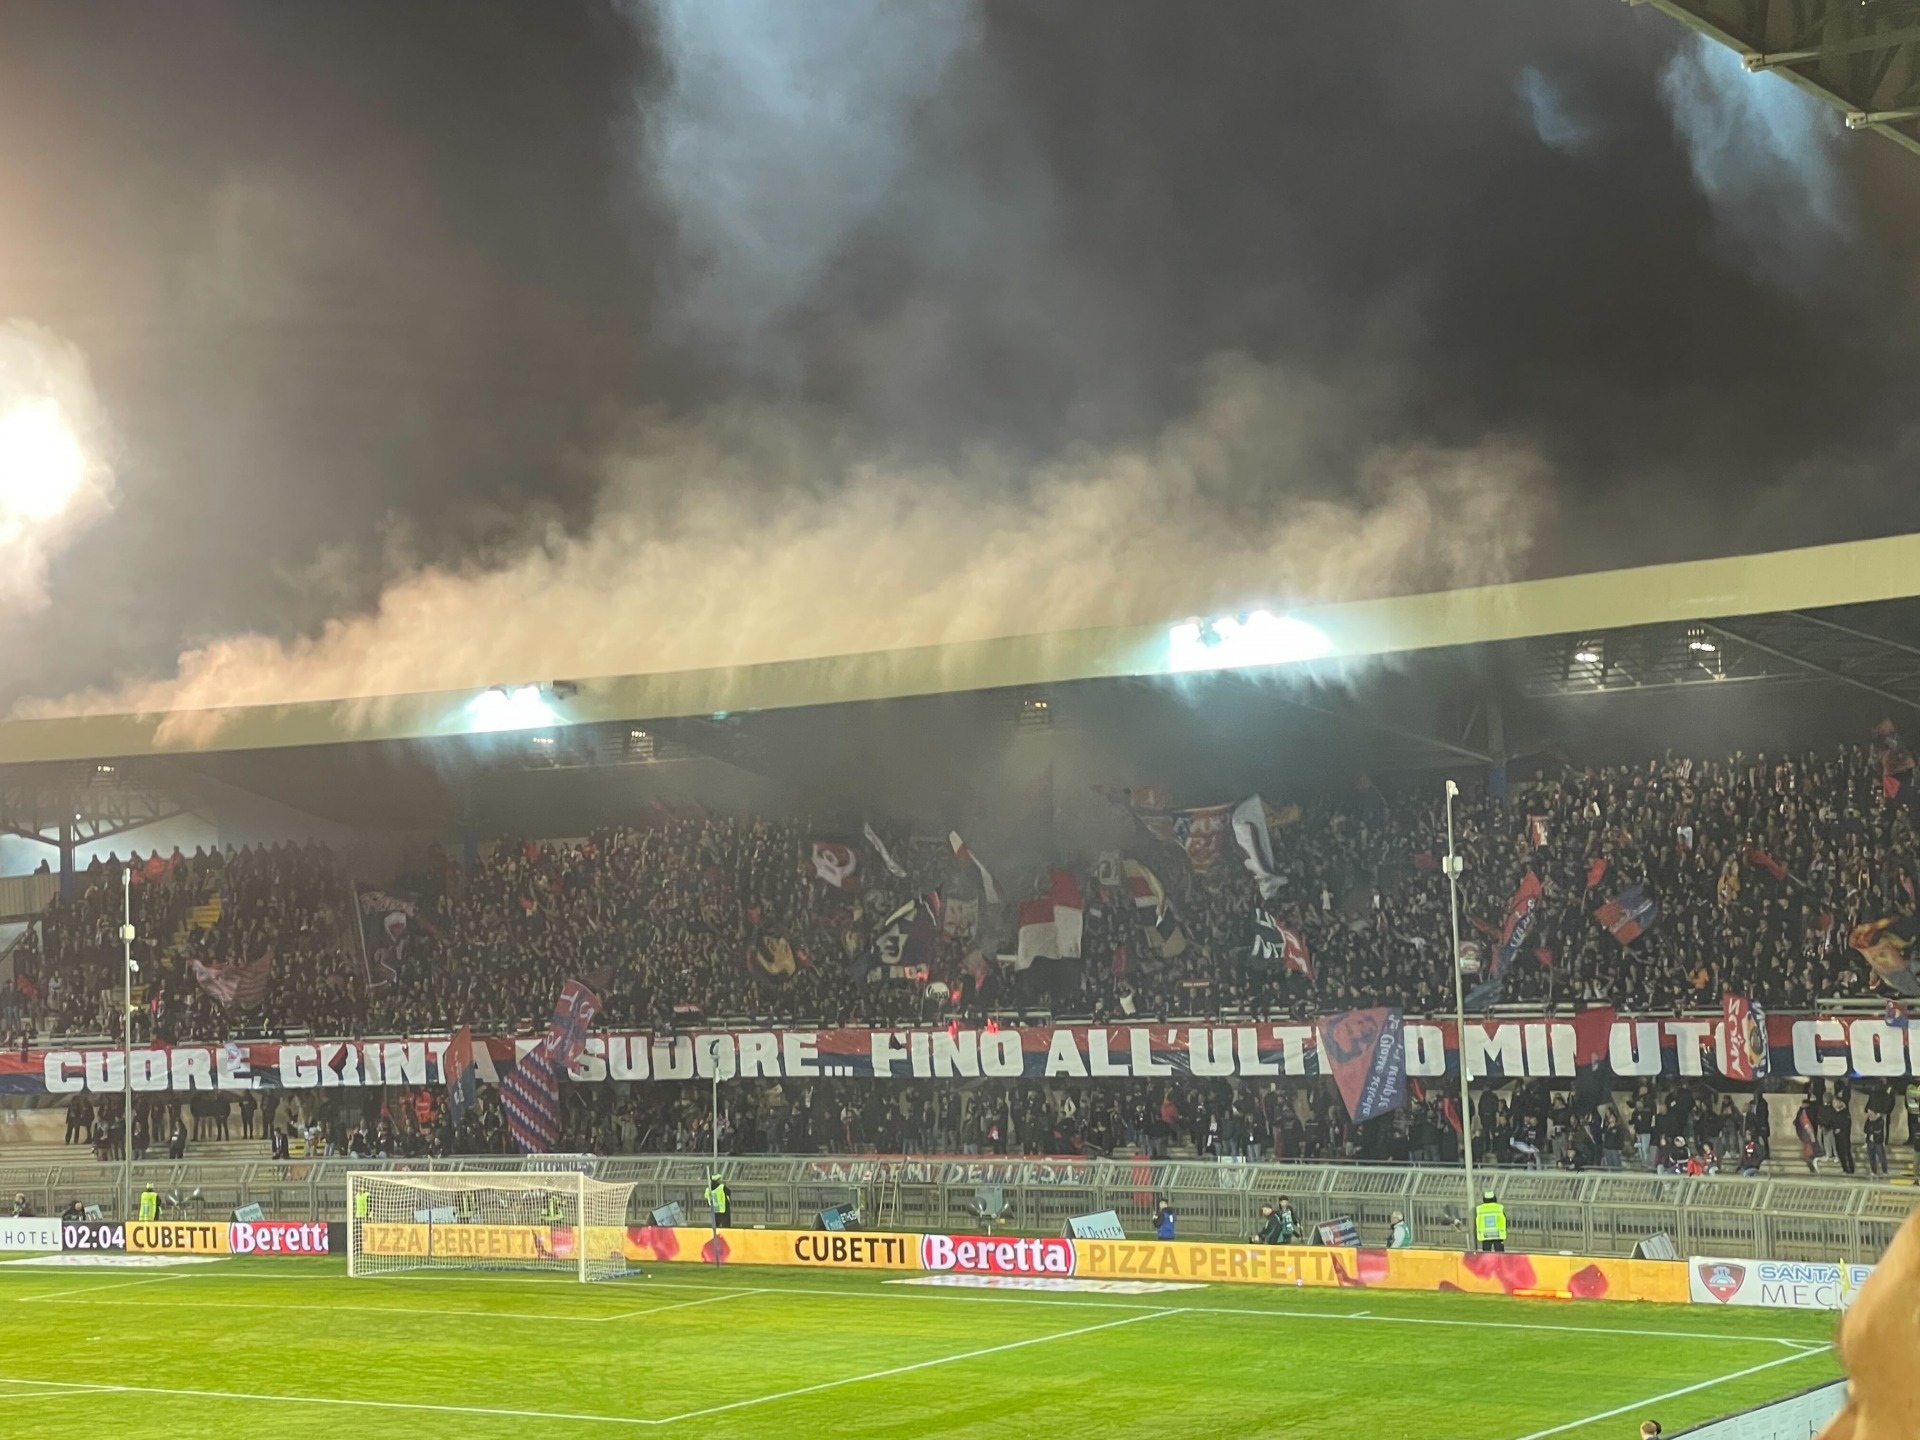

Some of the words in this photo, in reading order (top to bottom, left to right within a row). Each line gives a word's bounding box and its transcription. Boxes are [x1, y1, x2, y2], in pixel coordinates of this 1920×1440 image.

[871, 1030, 1024, 1077] FINO
[5, 1231, 59, 1245] HOTEL
[64, 1225, 125, 1249] 02:04
[132, 1226, 217, 1249] CUBETTI
[795, 1235, 905, 1265] CUBETTI
[930, 1234, 1068, 1273] Beretta
[1090, 1244, 1179, 1275] PIZZA
[1759, 1263, 1842, 1283] SANTA
